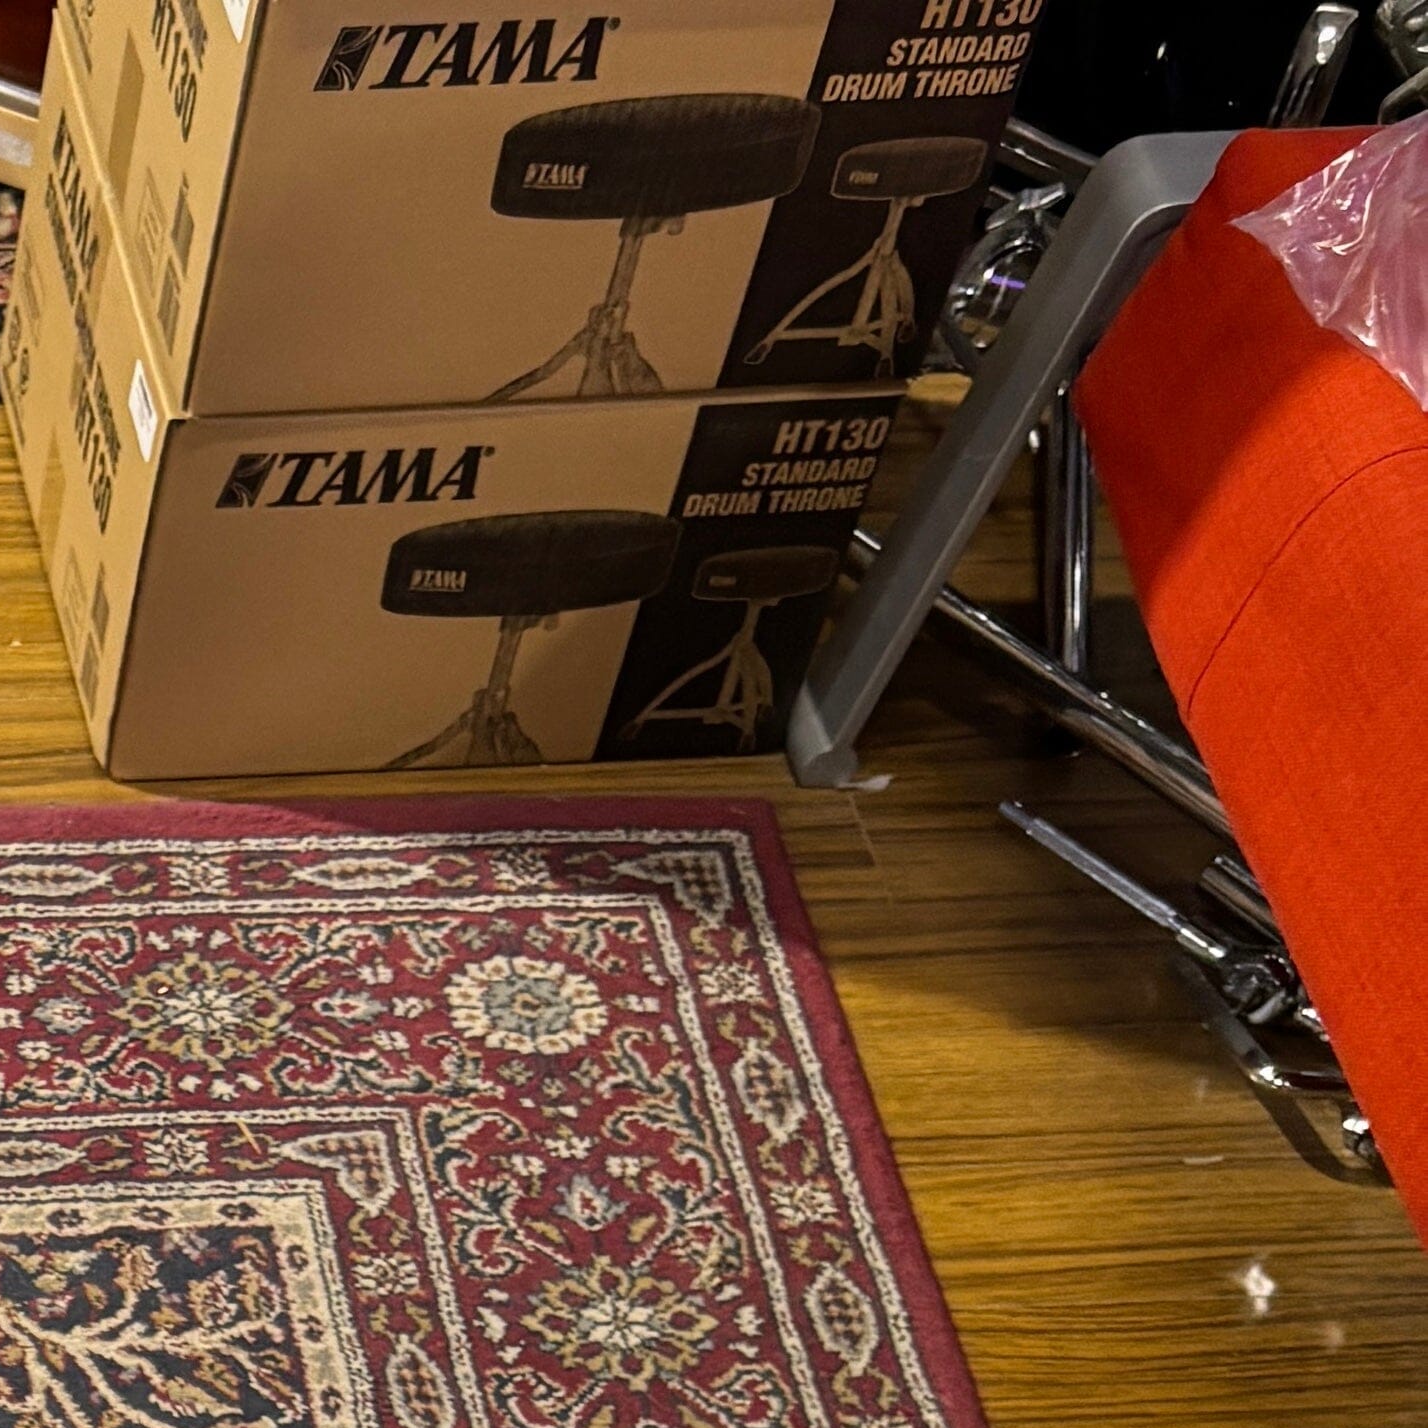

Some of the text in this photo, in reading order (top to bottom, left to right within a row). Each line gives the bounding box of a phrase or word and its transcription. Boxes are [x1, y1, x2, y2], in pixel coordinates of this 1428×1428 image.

[369, 17, 608, 89] TAMA
[886, 32, 1030, 66] STANDARD
[821, 63, 1020, 102] DRUM THRONE
[771, 416, 889, 455] HT130
[266, 446, 484, 507] TAMA
[741, 456, 876, 487] STANDARD
[683, 484, 868, 517] DRUM THRONE
